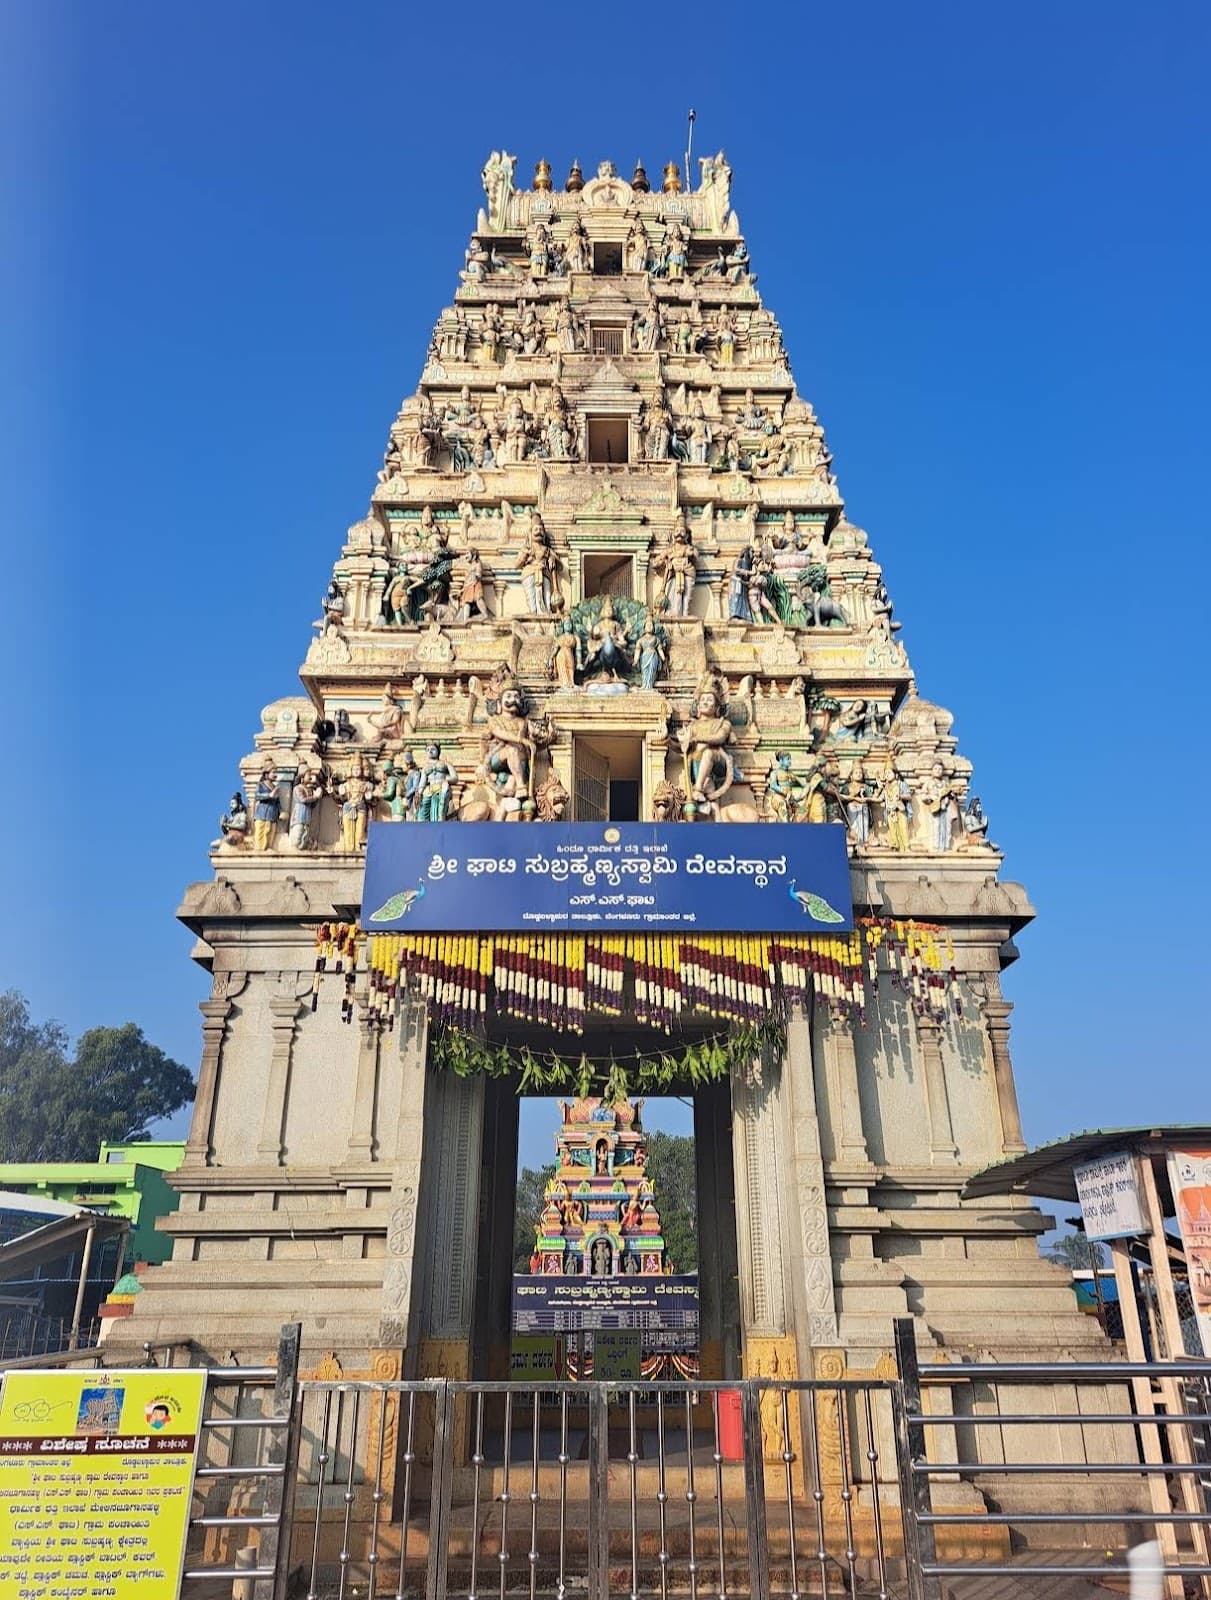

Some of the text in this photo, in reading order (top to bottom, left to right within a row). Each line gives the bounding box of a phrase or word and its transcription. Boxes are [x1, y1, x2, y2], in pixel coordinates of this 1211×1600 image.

[427, 853, 787, 889] ಶ್ರೀ ಘಾಟಿ ಸುಬ್ರಹ್ಮಣ್ಯಸ್ವಾಮಿ ದೇವಸ್ಥಾನ
[40, 1436, 150, 1453] ವಿಶೇಷ ಸೂಚನೆ
